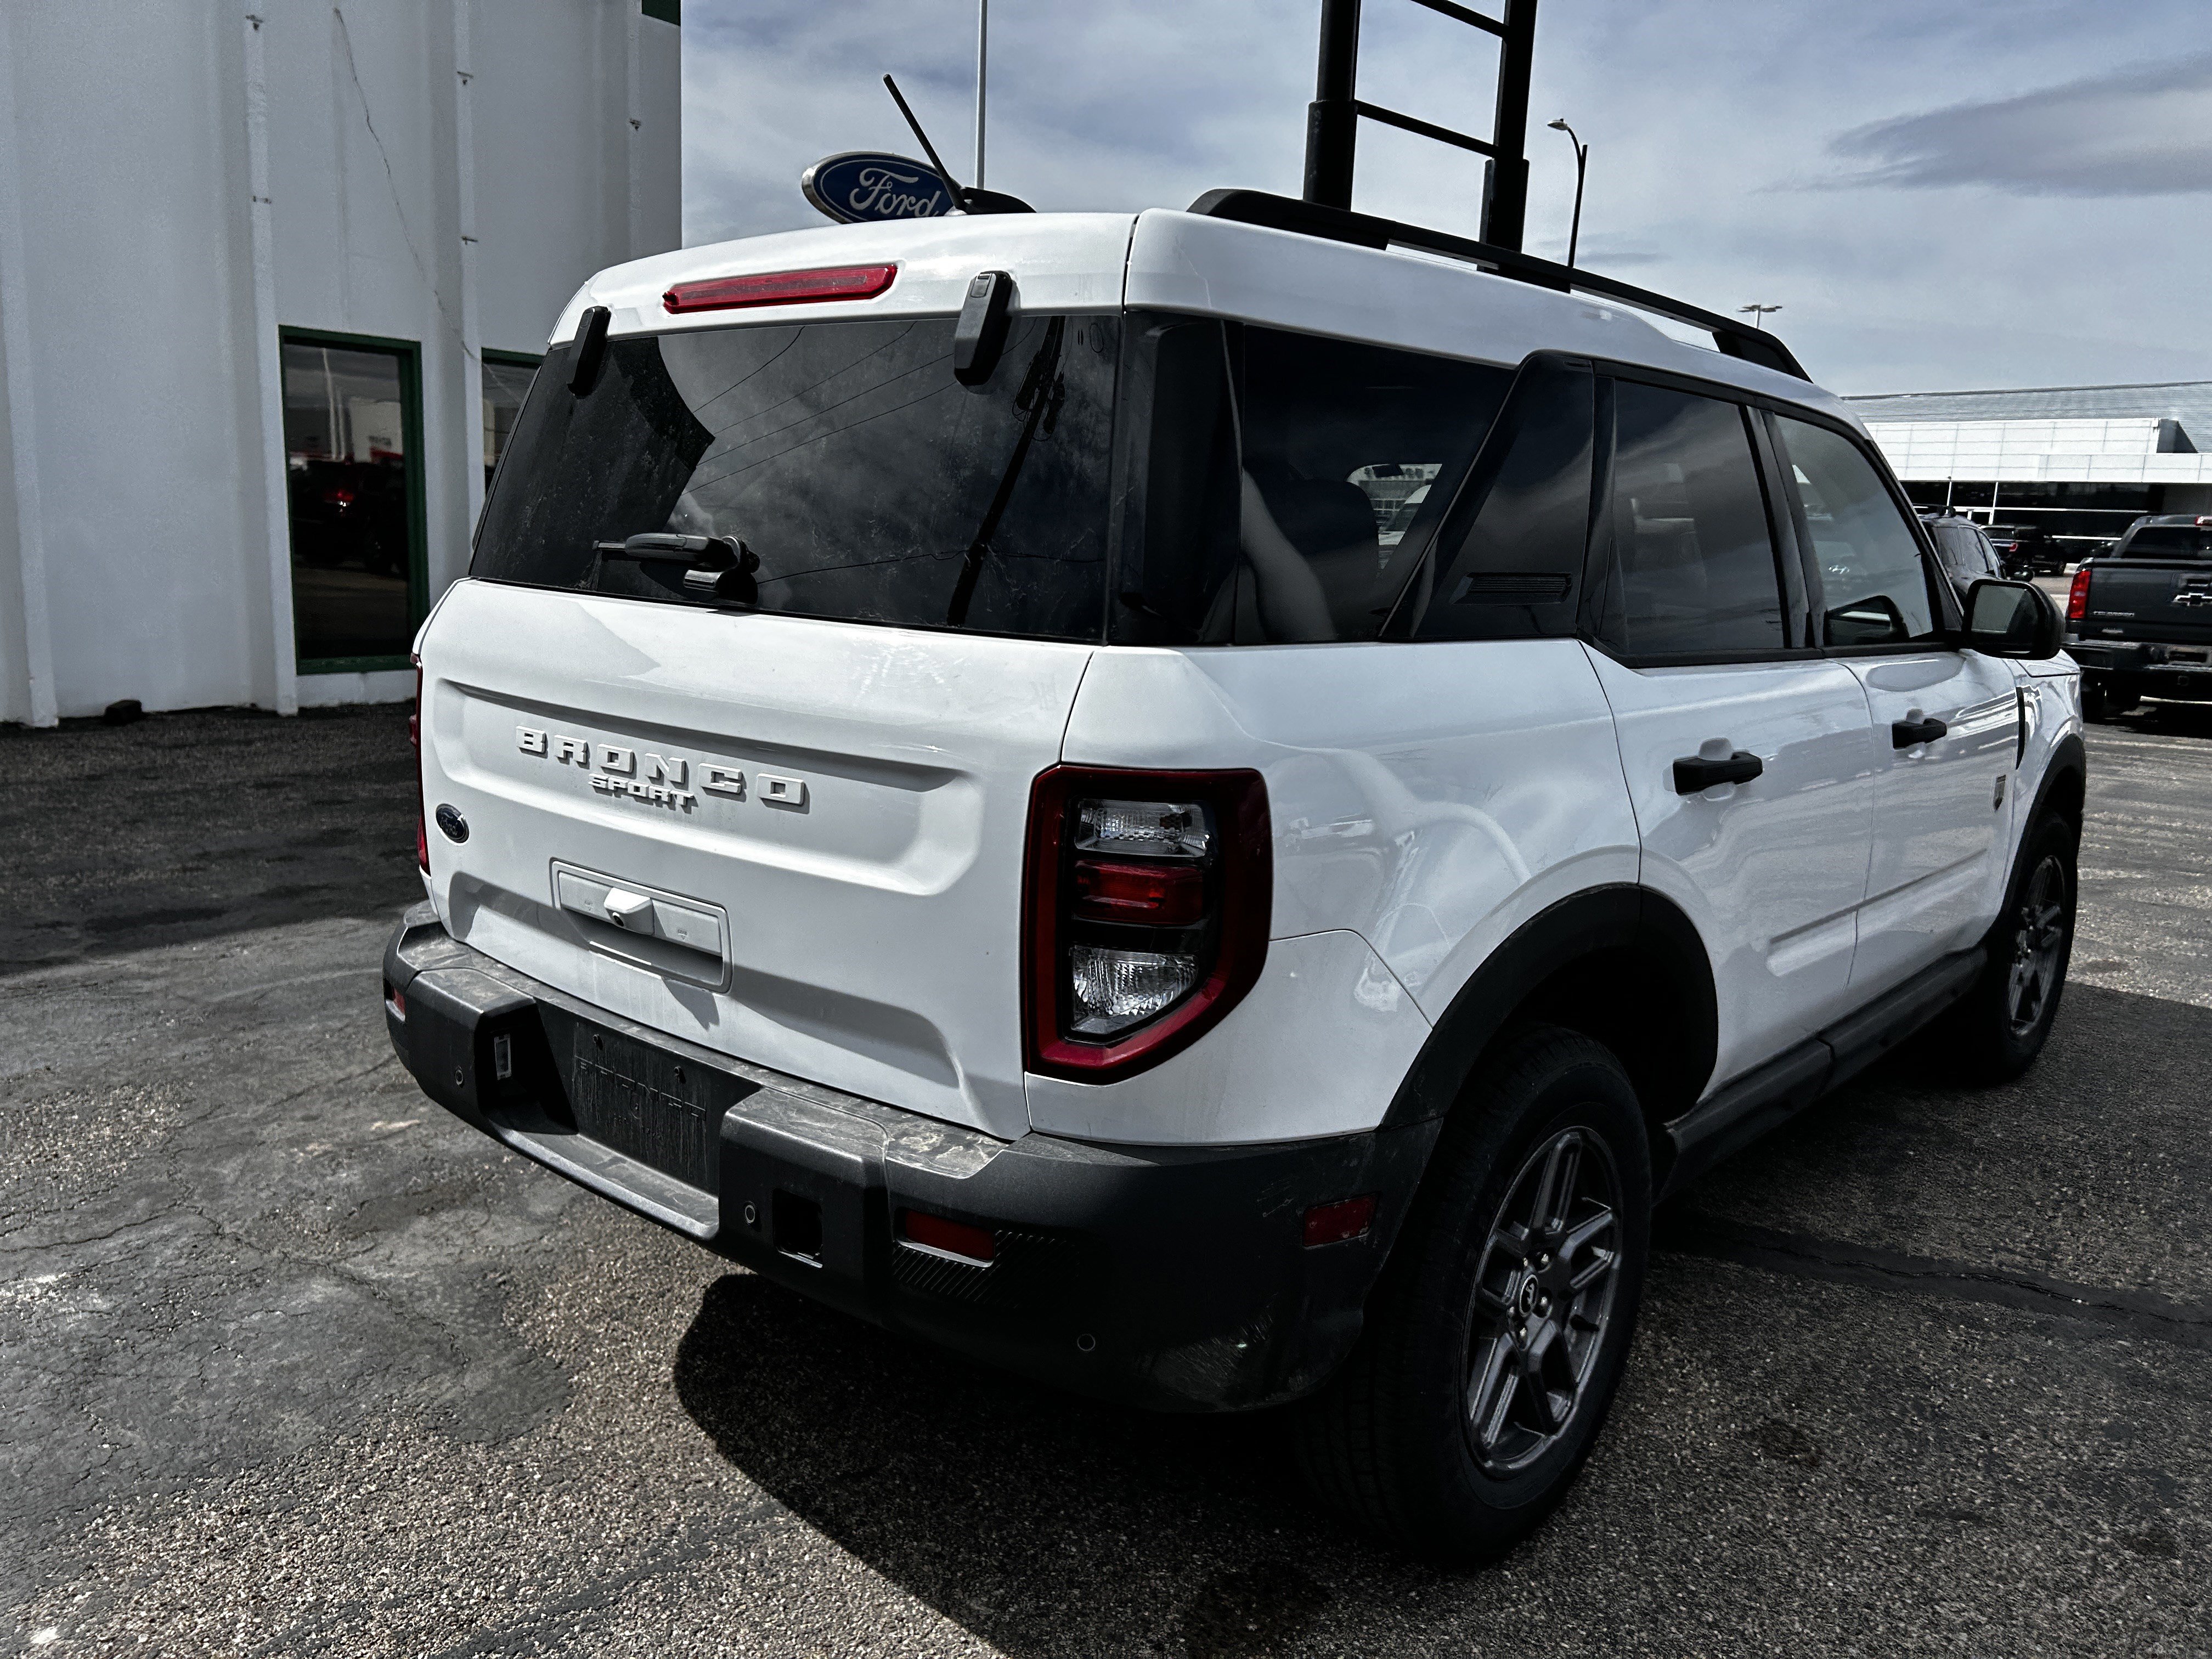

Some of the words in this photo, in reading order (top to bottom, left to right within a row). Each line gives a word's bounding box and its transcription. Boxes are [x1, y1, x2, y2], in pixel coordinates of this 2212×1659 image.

[849, 167, 941, 217] Ford
[516, 725, 806, 806] BRONCO
[588, 773, 695, 806] SPORT
[439, 811, 458, 836] Ford
